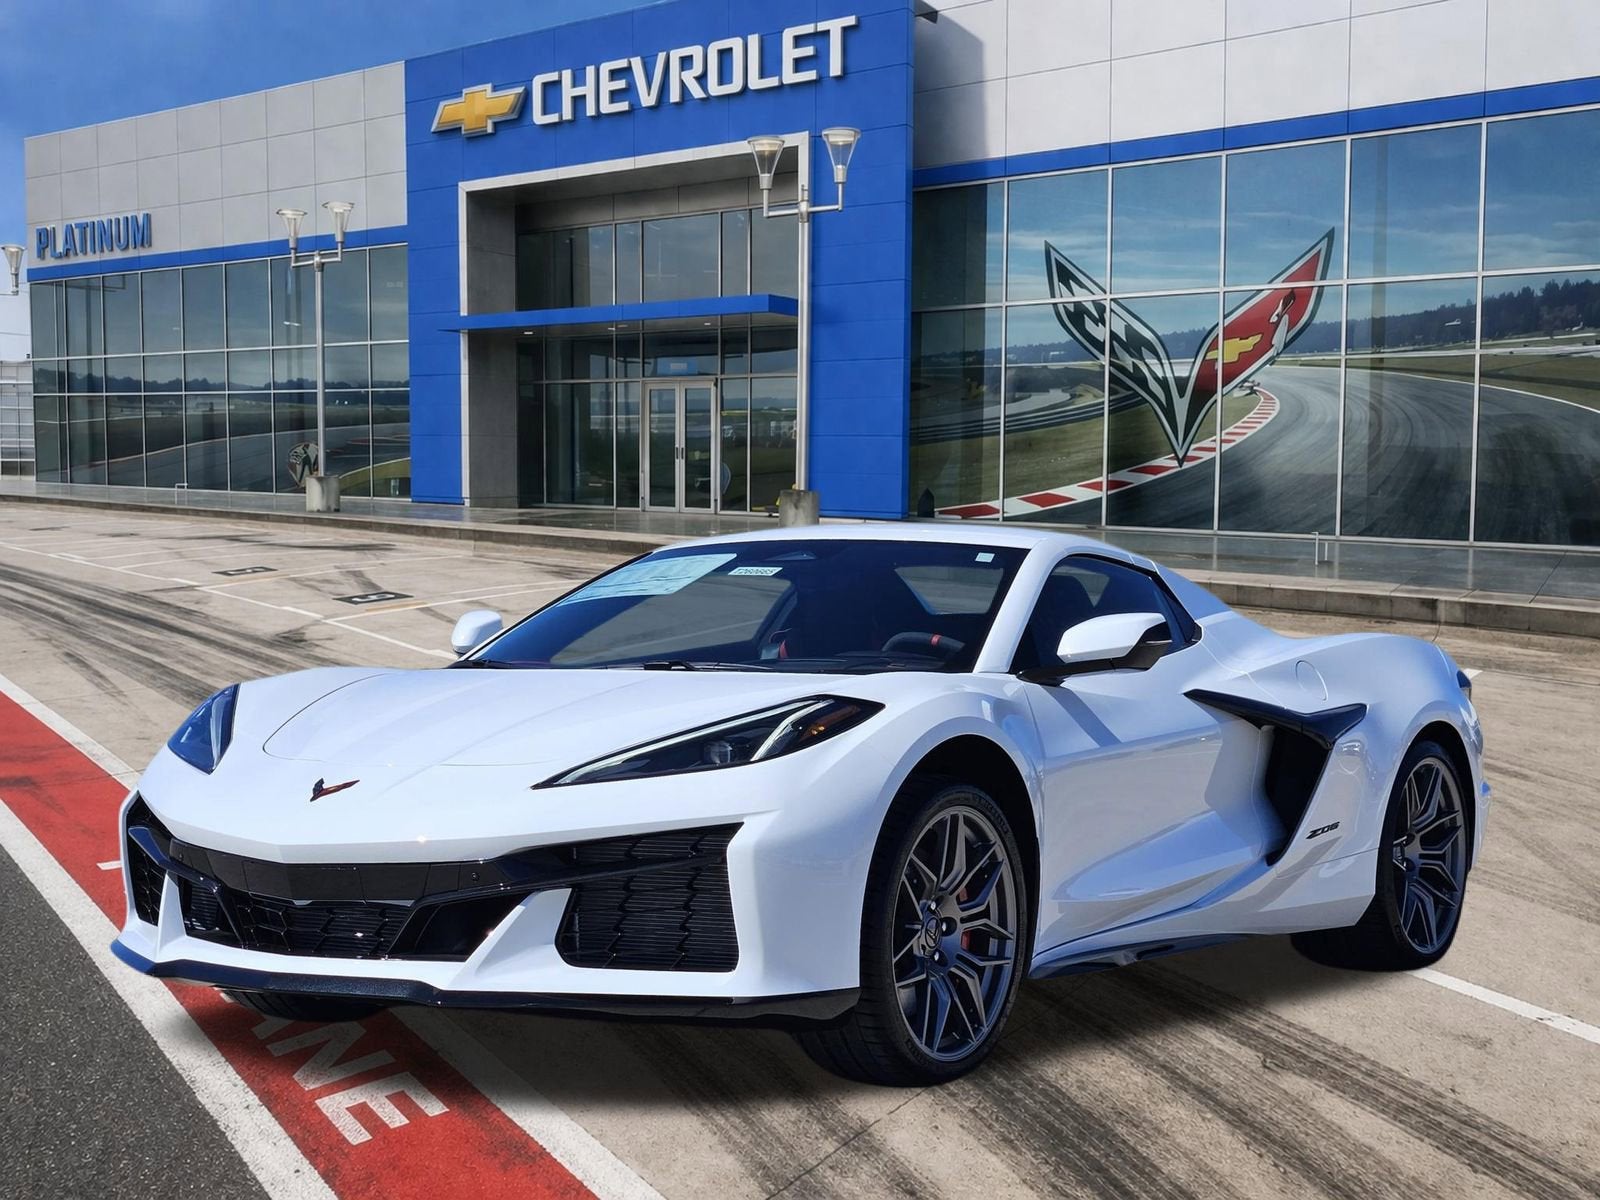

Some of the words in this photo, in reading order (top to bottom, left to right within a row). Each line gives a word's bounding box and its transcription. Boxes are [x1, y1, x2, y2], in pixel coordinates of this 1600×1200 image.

[532, 15, 858, 125] CHEVROLET
[36, 213, 151, 259] PLATINUM
[1305, 821, 1340, 840] Z06
